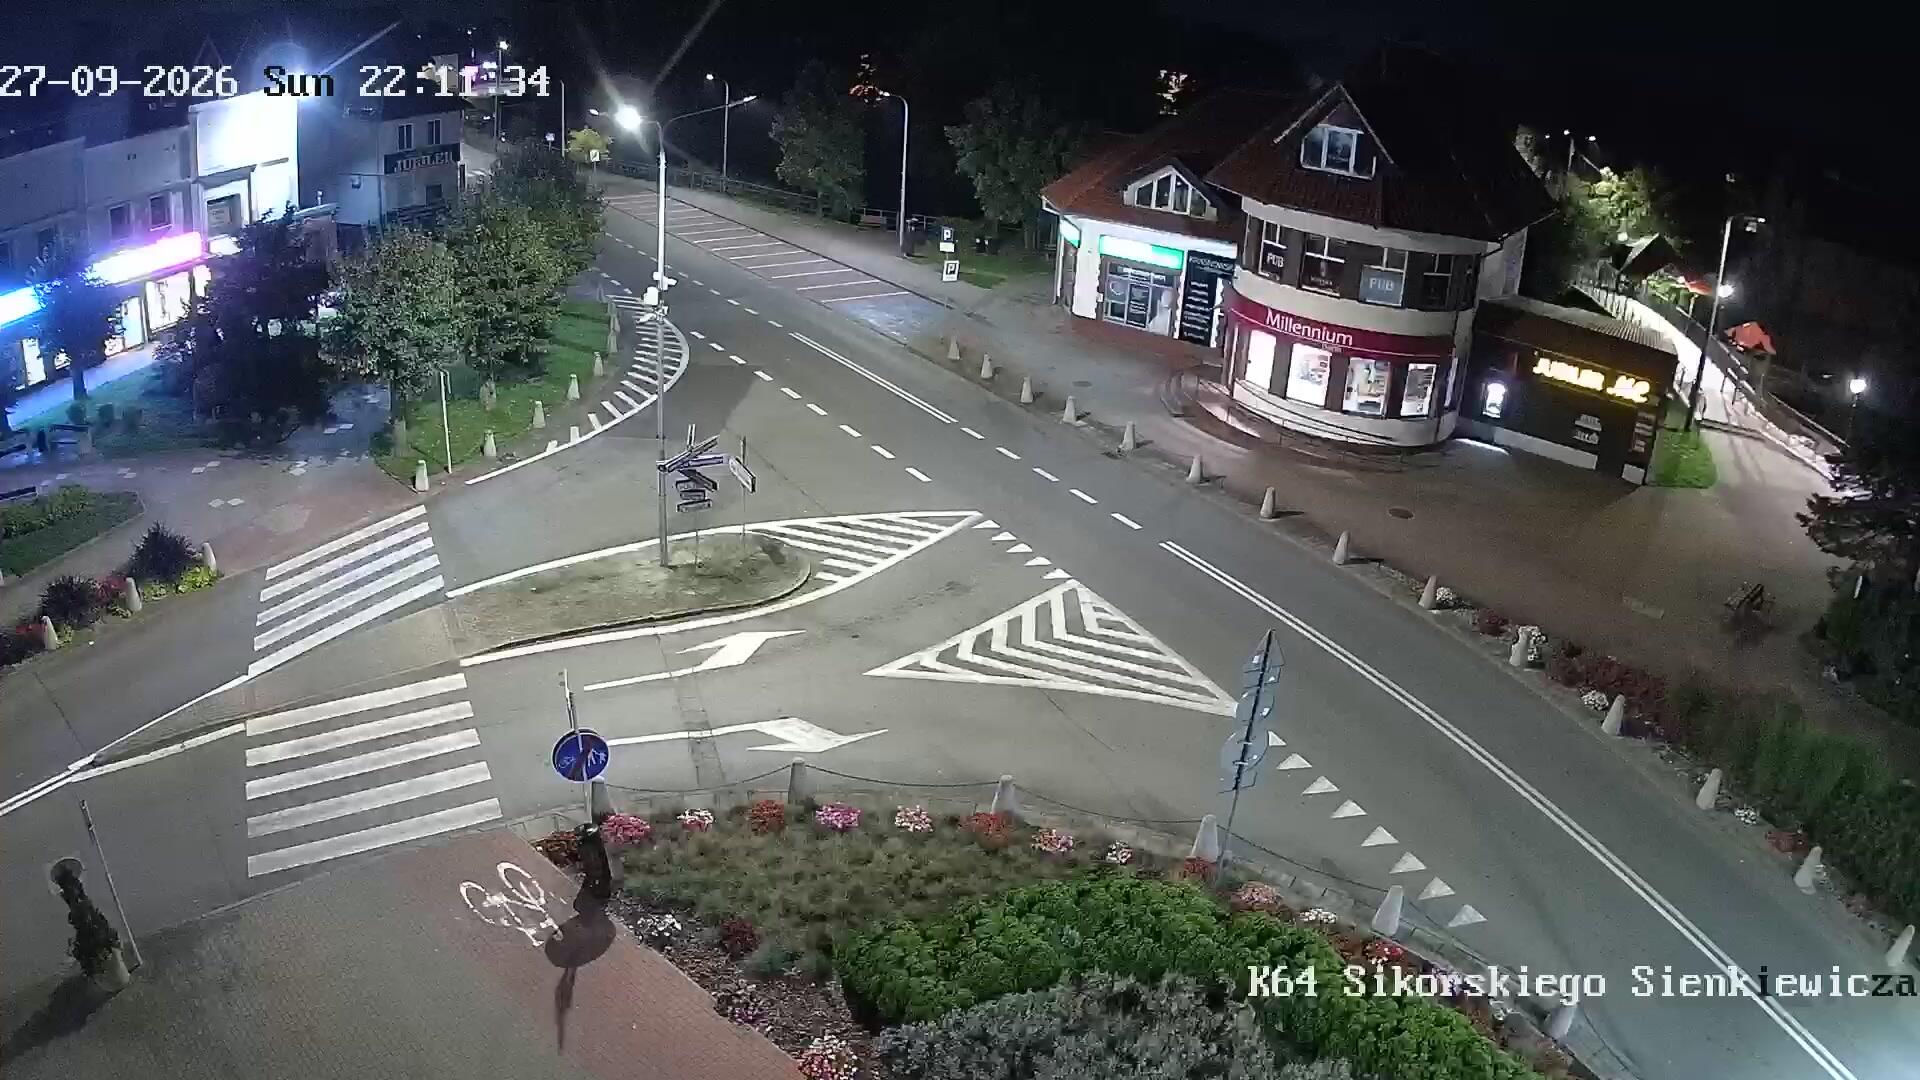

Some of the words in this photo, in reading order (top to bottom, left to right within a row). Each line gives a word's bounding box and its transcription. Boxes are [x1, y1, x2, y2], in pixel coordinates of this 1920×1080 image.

[943, 229, 951, 240] P
[1266, 252, 1284, 268] PUB
[1369, 277, 1395, 291] PUB
[1265, 308, 1353, 346] Millennium
